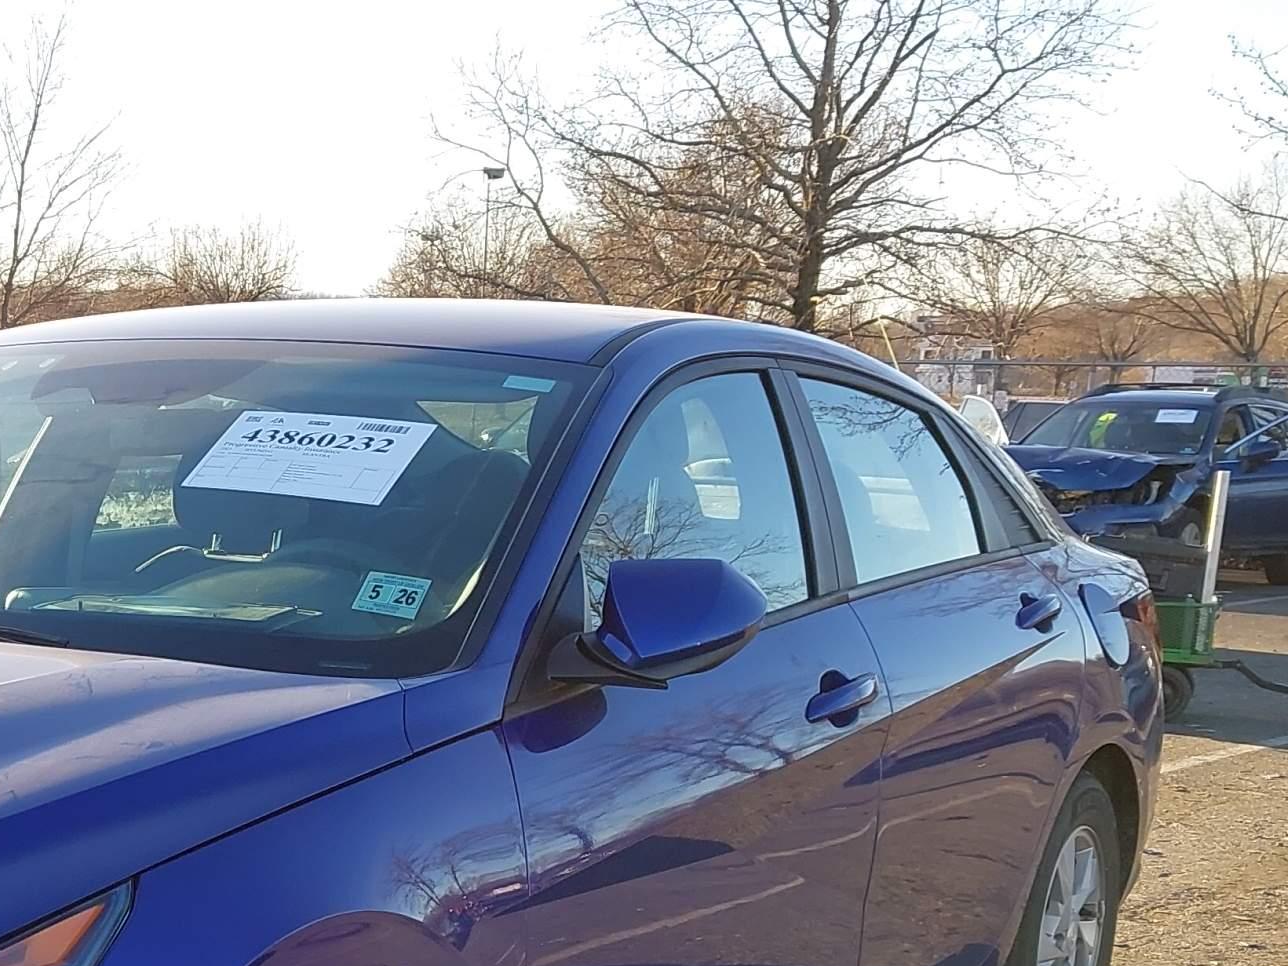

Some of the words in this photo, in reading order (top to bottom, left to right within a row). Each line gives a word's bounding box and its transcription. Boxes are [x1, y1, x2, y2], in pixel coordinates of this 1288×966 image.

[223, 441, 269, 450] Progressive
[241, 428, 395, 454] 43860232
[368, 584, 383, 600] 5
[393, 588, 419, 606] 26
